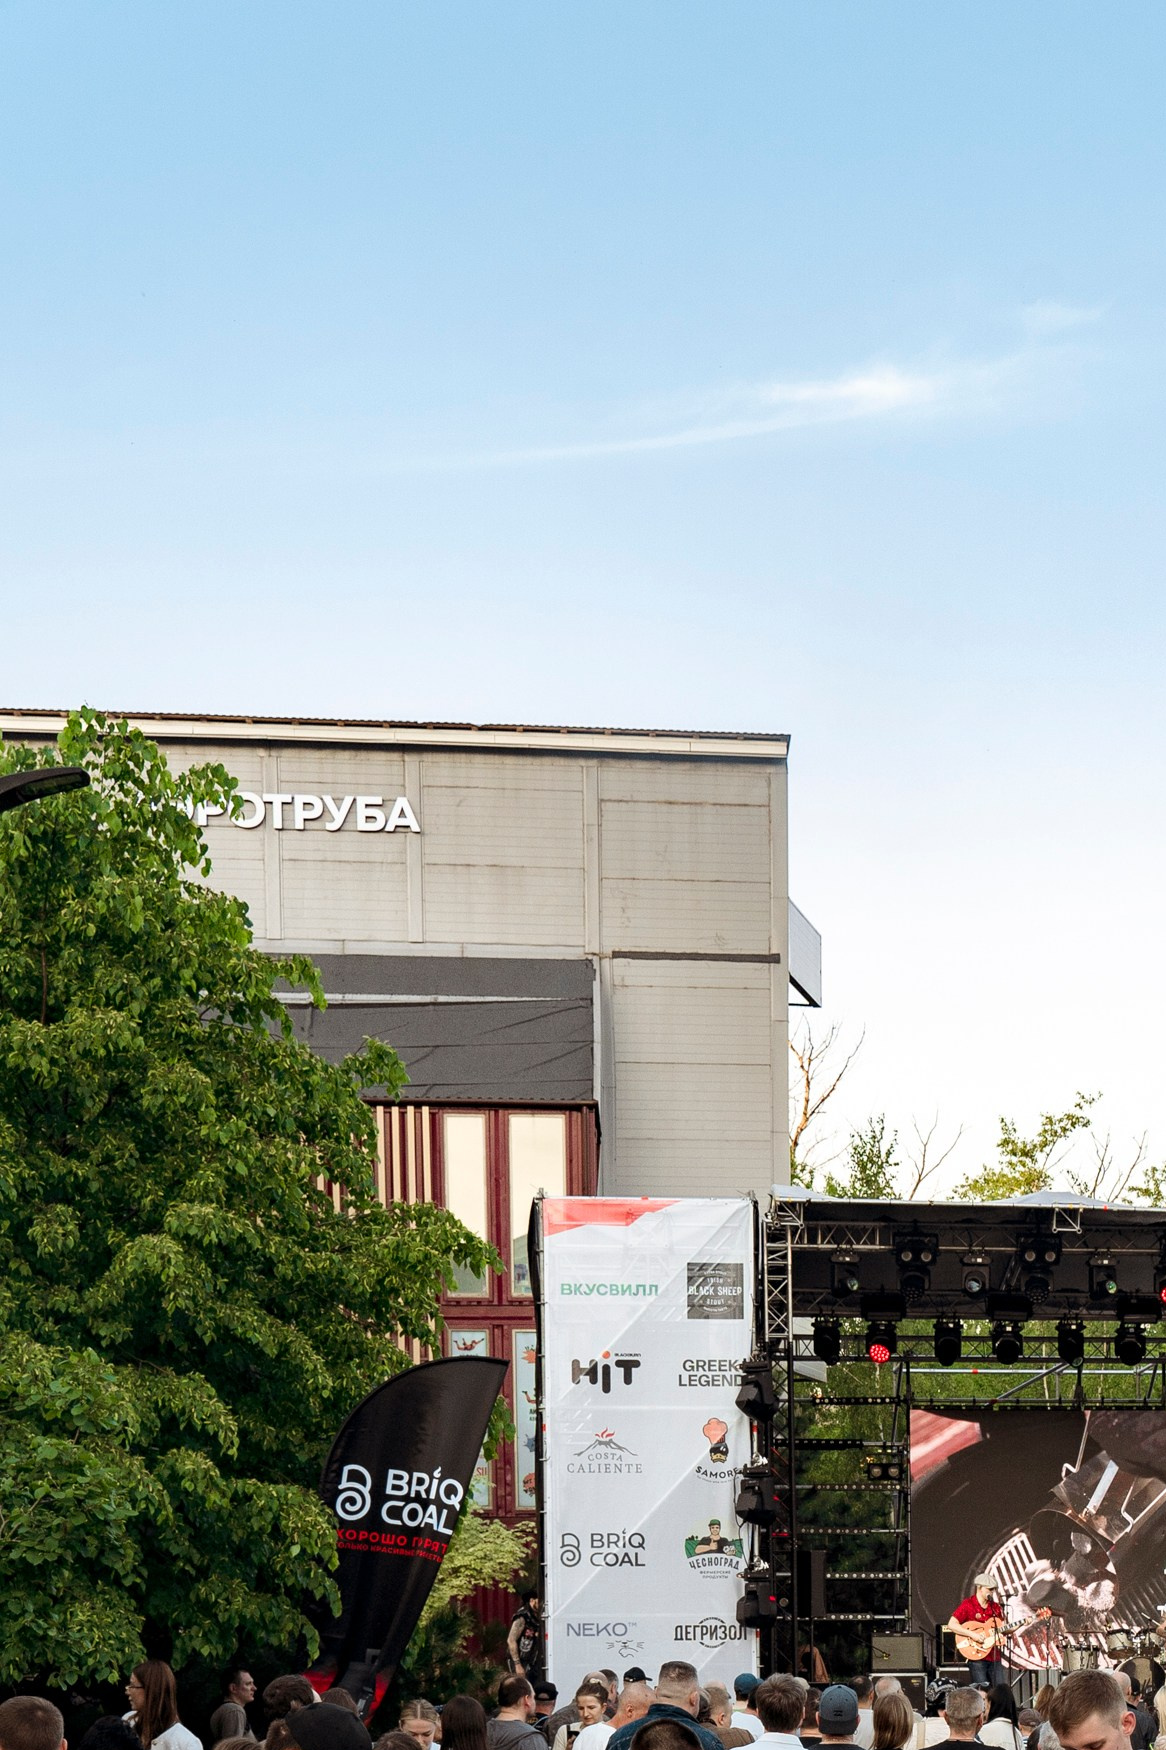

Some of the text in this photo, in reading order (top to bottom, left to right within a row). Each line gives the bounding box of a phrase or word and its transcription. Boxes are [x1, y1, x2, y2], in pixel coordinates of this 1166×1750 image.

[560, 1283, 659, 1297] ВКУСВИЛЛ
[688, 1285, 742, 1296] BLACK SHEEP
[683, 1359, 740, 1372] GREEK
[588, 1452, 623, 1462] COSTA
[566, 1463, 643, 1474] CALIENTE
[381, 1500, 454, 1535] COAL
[337, 1529, 407, 1547] ХОРОШО
[337, 1541, 369, 1551] ОЛЬКО
[590, 1552, 646, 1567] COAL
[689, 1556, 740, 1570] ЧЕСНОГРАД
[674, 1625, 748, 1641] ДЕГРИЗОЛ
